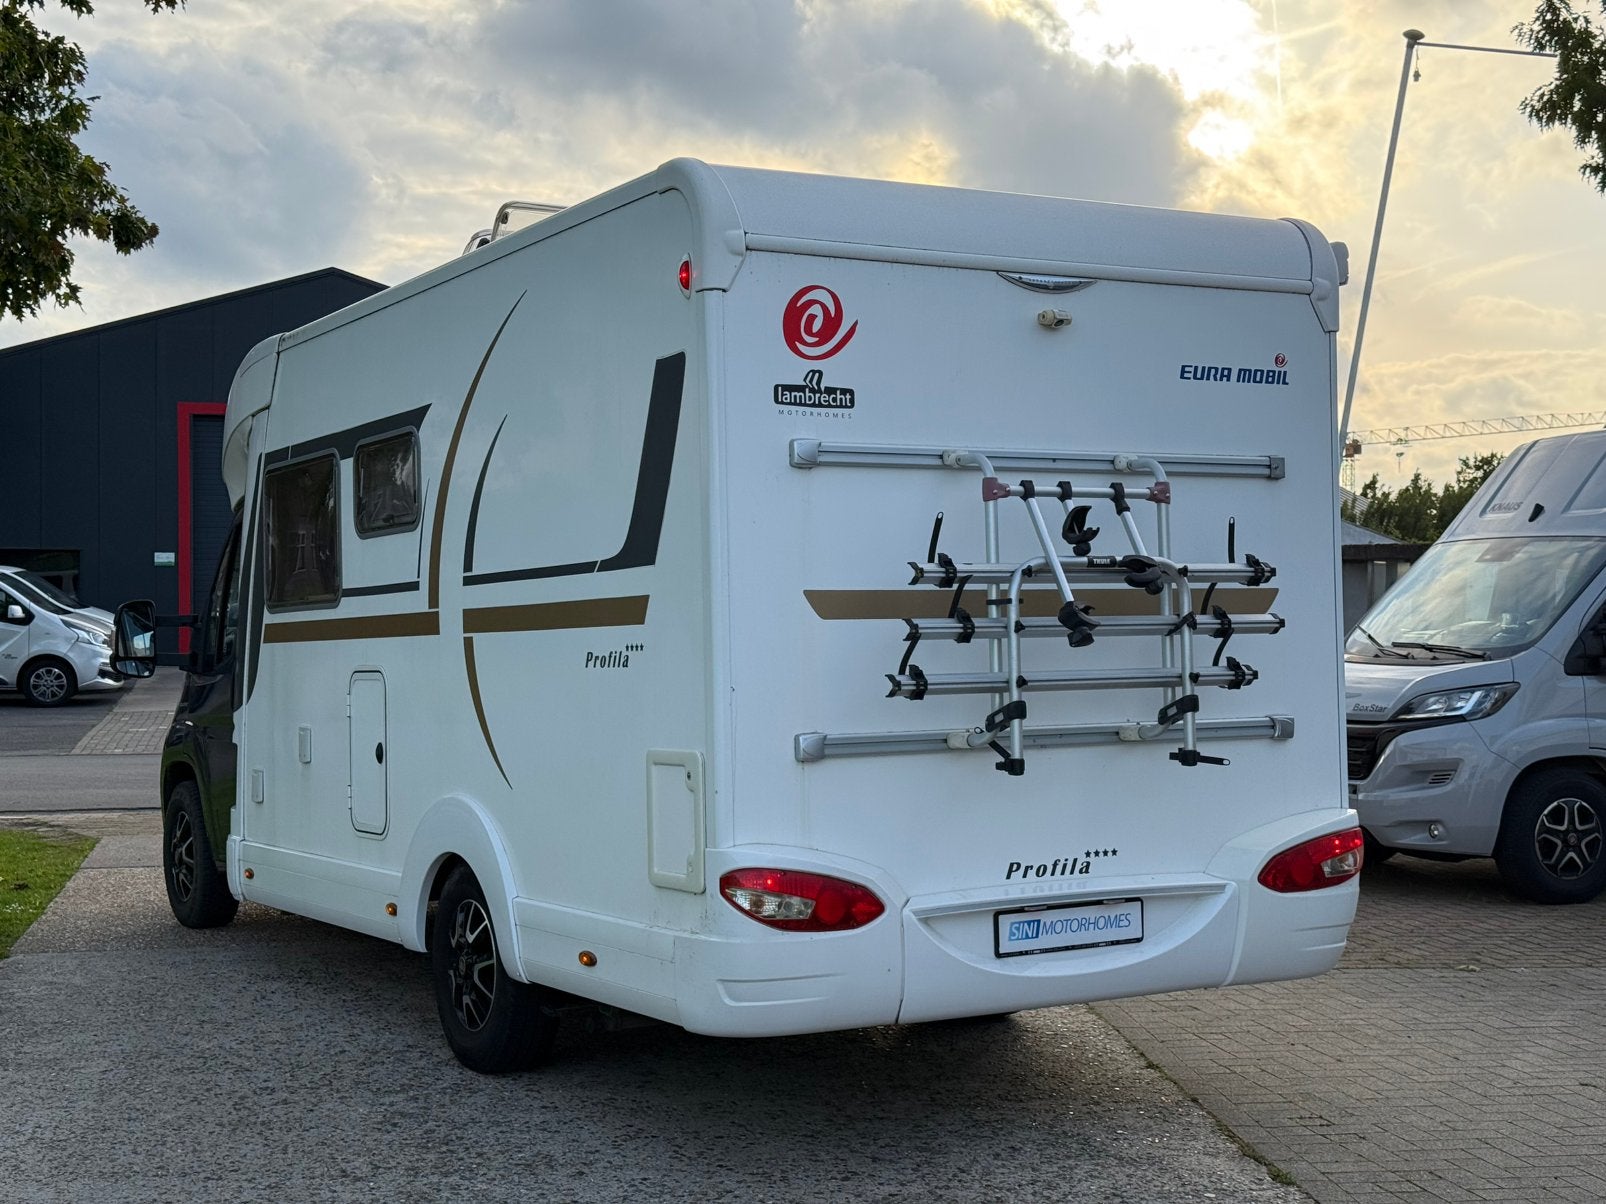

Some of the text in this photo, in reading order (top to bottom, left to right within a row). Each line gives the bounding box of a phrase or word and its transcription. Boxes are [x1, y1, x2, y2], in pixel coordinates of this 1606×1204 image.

[1179, 364, 1289, 386] EURA MOBIL
[778, 386, 852, 406] lambrecht
[778, 409, 852, 419] MOTORHOMES
[585, 650, 629, 668] Profila
[1352, 703, 1388, 713] BoxStar
[1005, 857, 1092, 880] Profila
[1009, 913, 1131, 940] SINI MOTORHOMES
